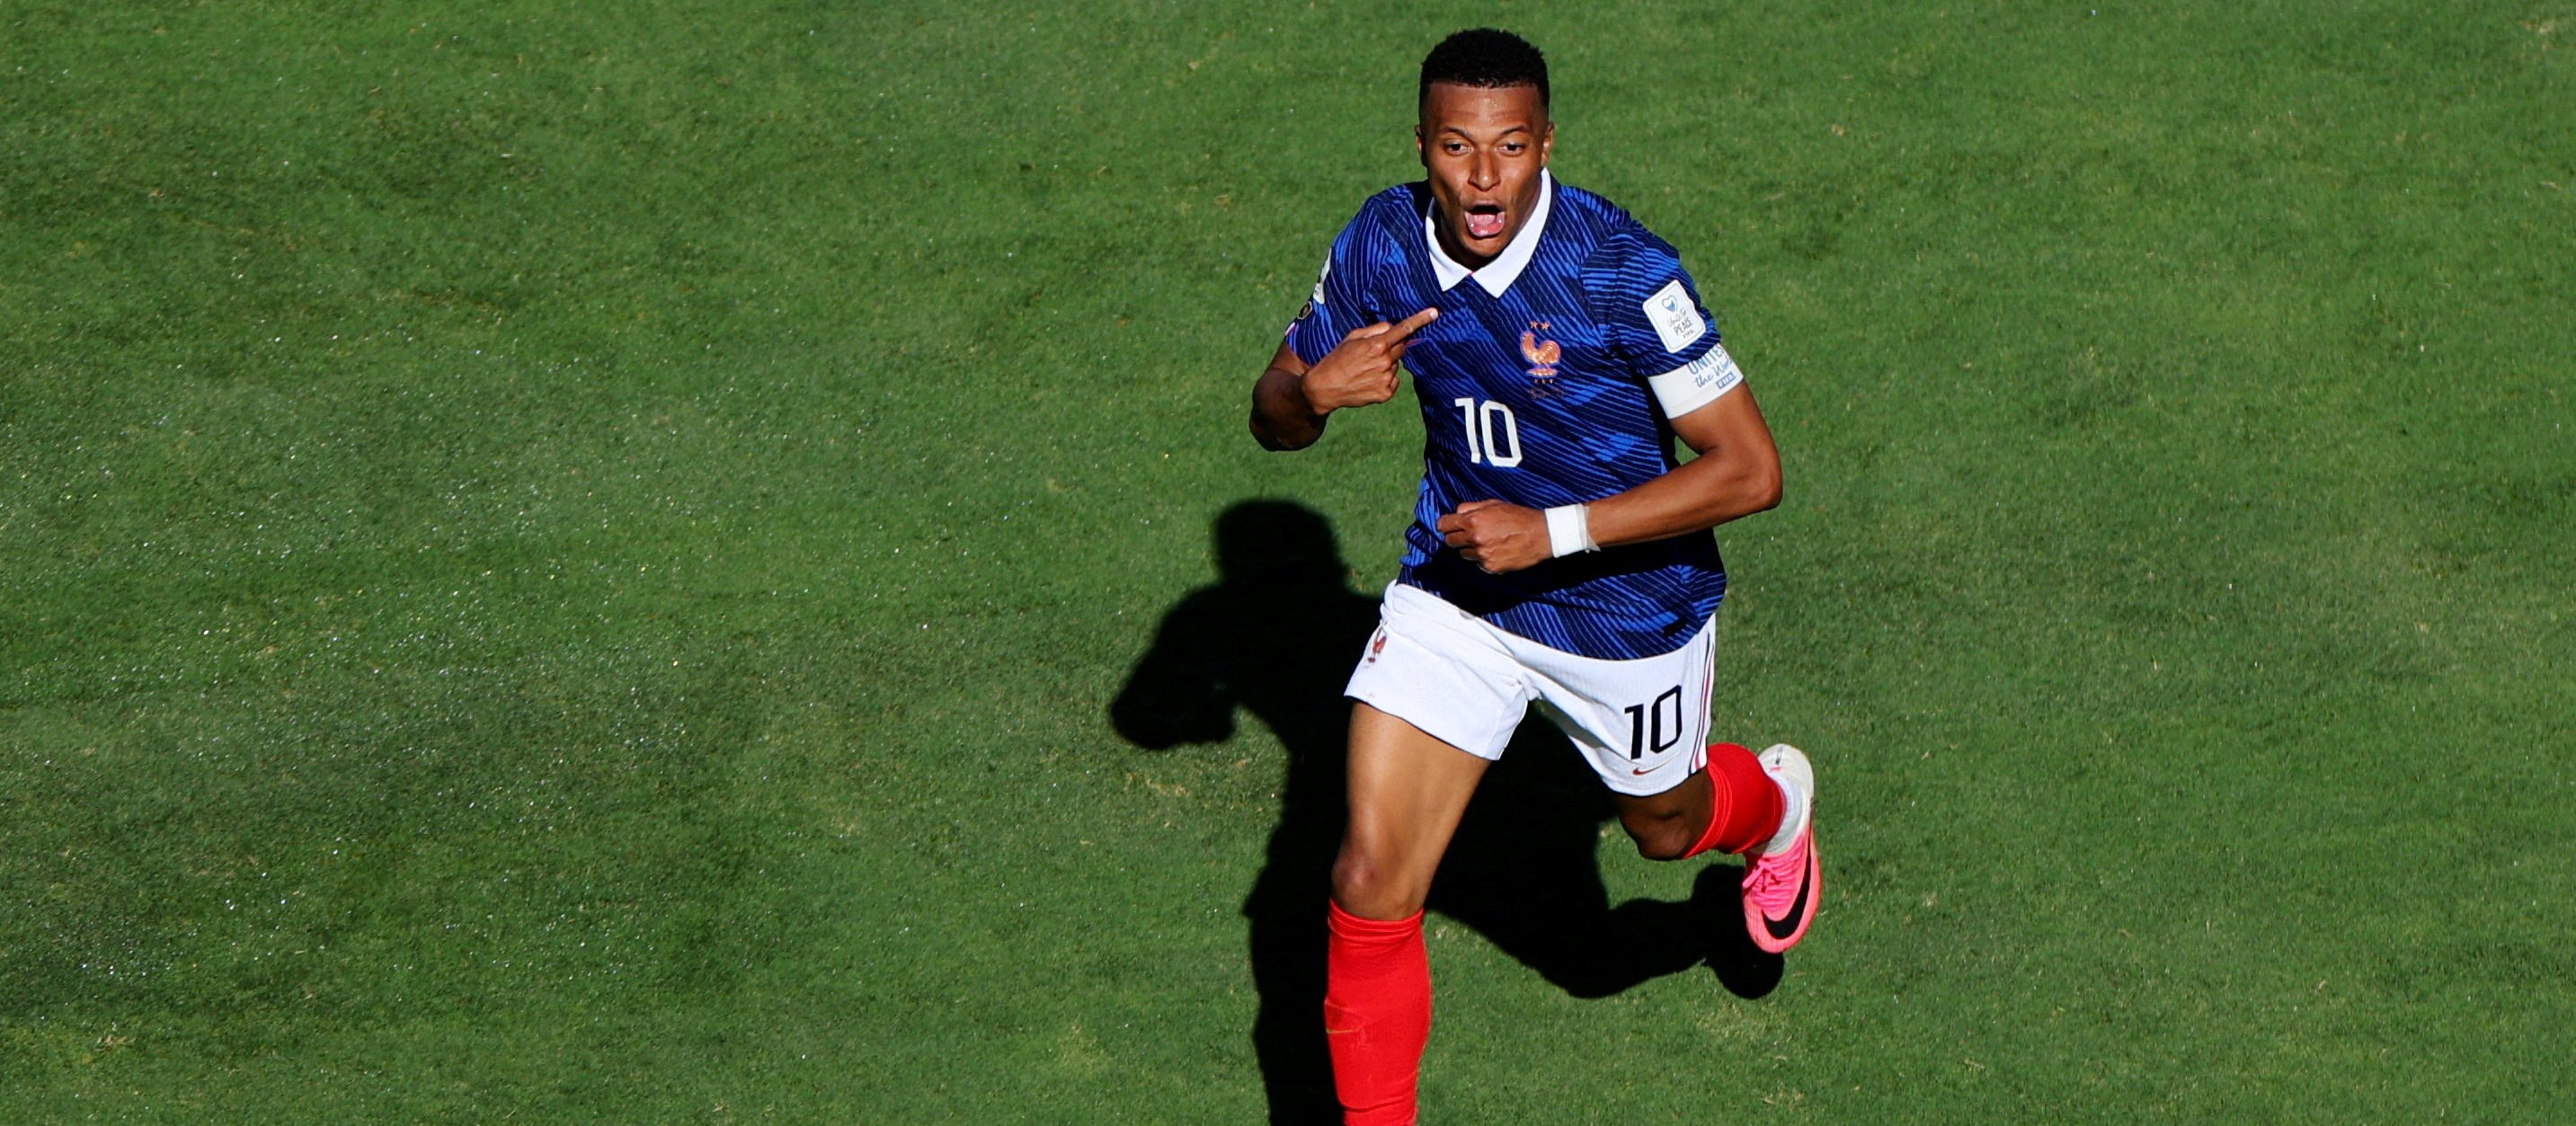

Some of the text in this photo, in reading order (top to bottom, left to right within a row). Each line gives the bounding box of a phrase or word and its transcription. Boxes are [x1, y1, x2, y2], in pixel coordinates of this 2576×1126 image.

[1693, 374, 1713, 388] the
[1454, 397, 1523, 467] 10
[1624, 684, 1683, 760] 10
